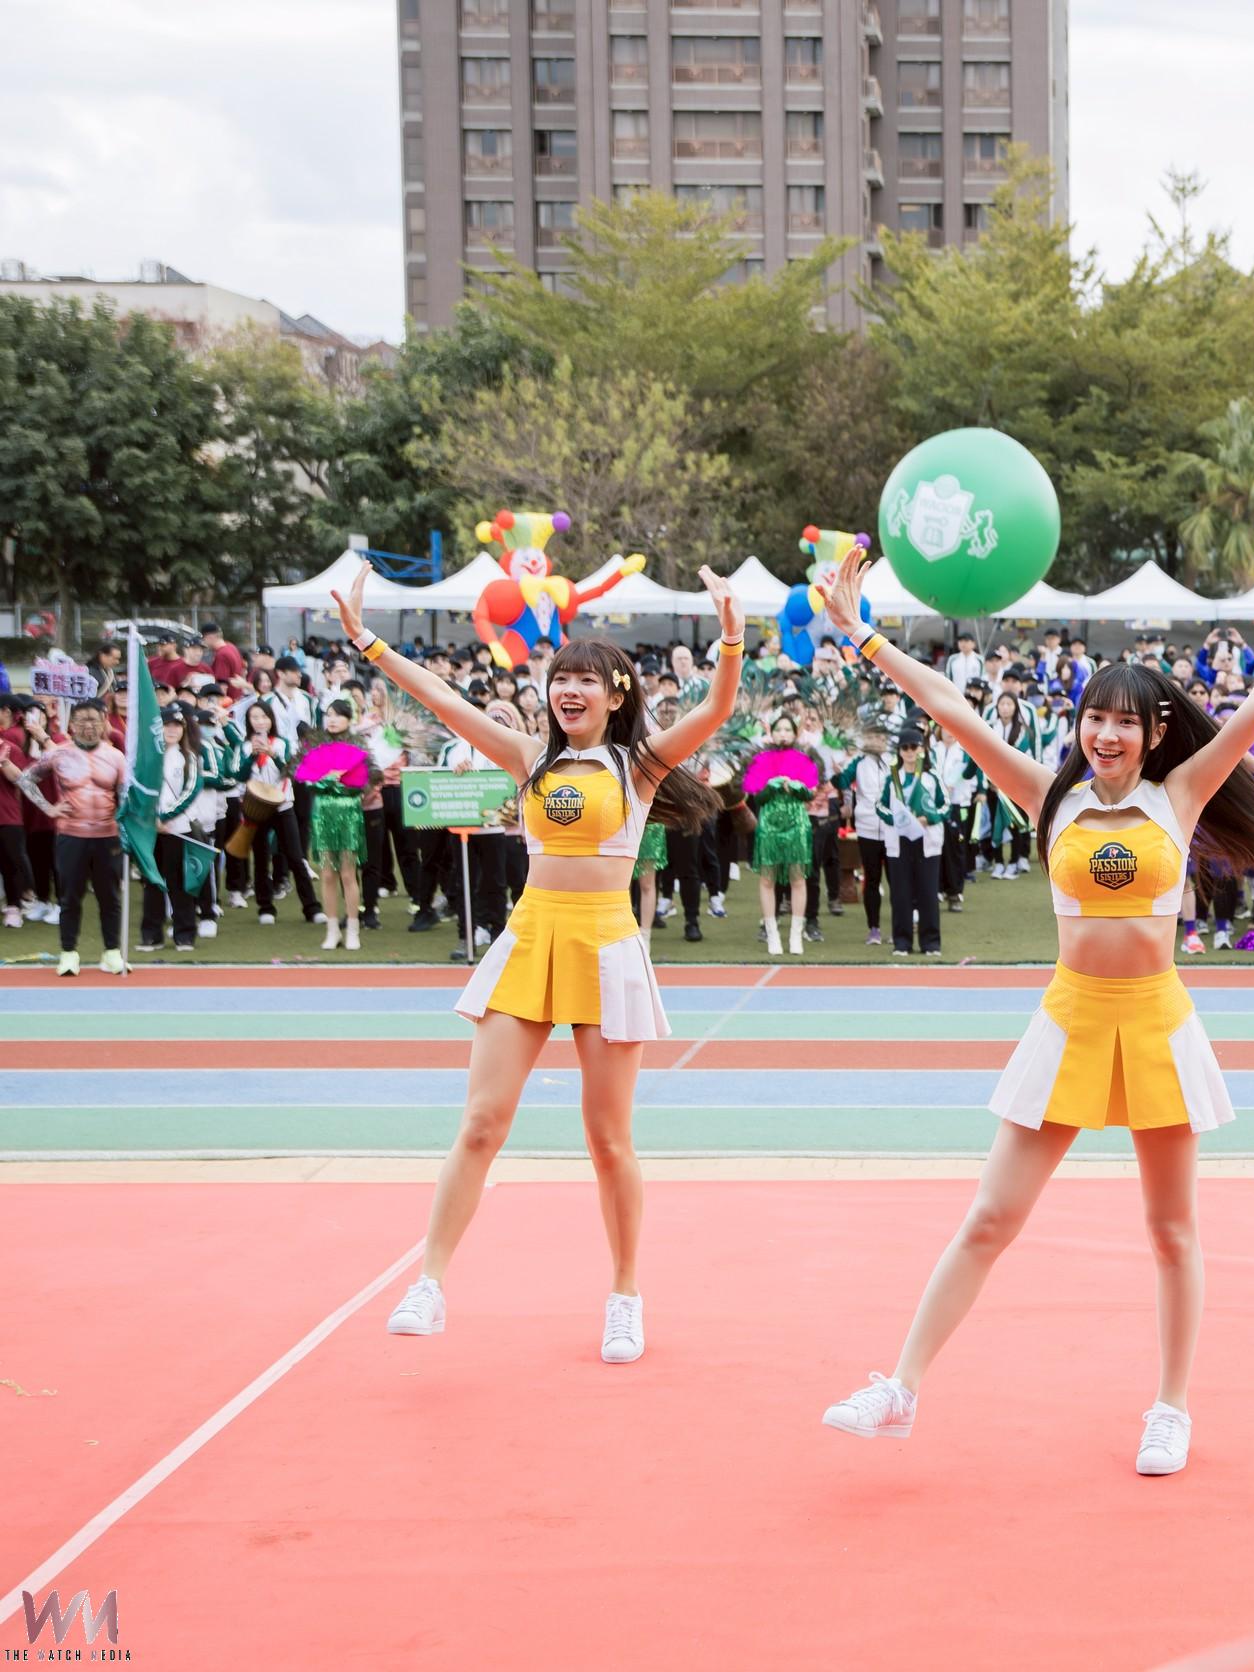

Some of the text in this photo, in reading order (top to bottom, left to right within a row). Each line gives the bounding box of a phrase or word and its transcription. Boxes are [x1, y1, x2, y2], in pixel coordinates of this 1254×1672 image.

[545, 797, 584, 809] PASSION
[1091, 857, 1136, 872] PASSION
[1100, 872, 1128, 881] SISTERS
